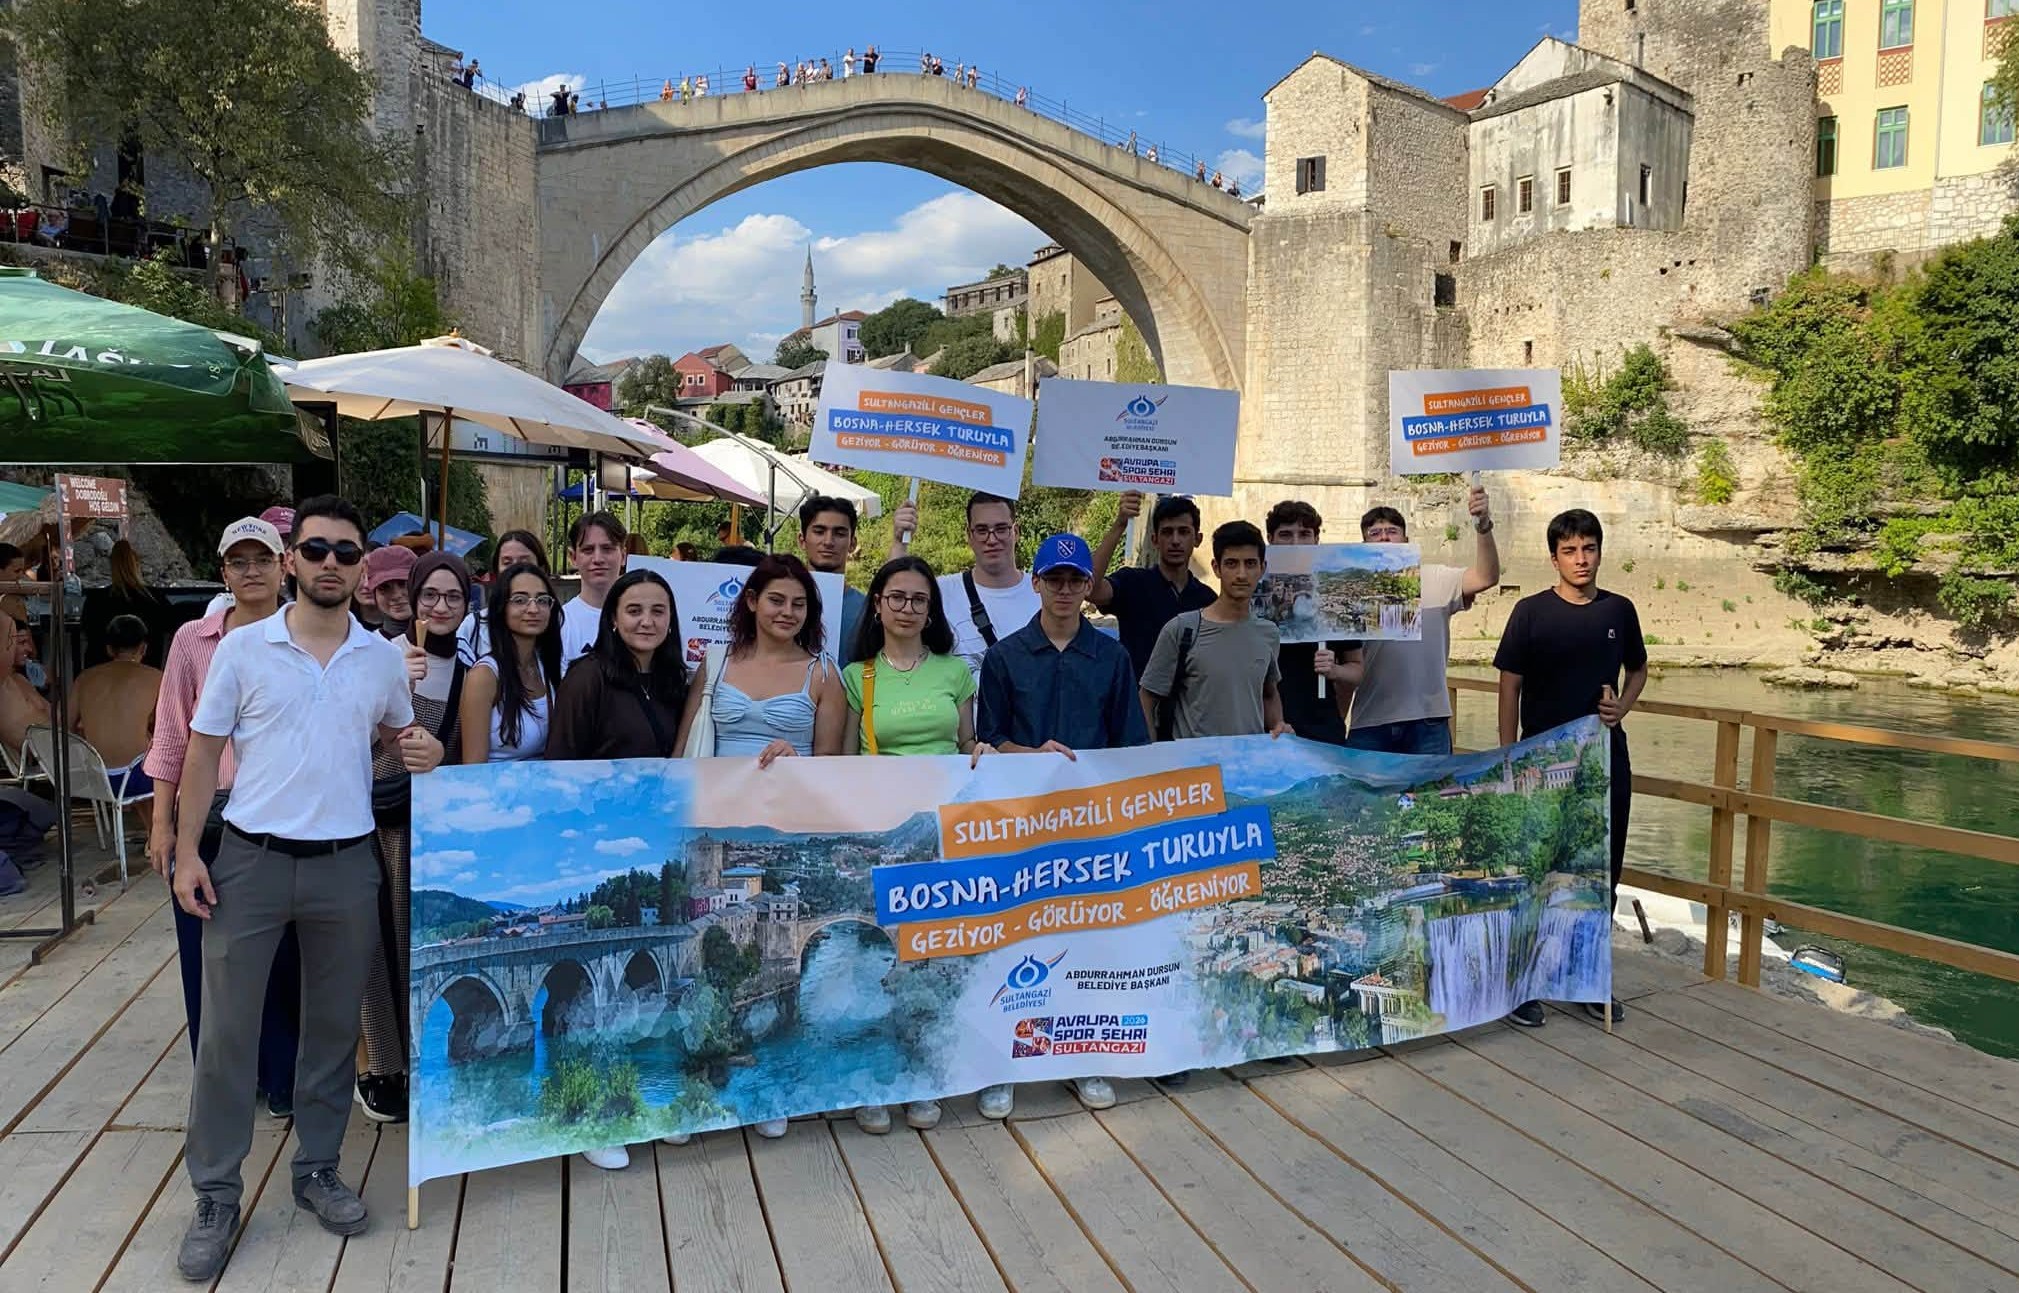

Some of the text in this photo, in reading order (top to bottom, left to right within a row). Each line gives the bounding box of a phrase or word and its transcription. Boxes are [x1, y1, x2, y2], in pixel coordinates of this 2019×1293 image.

[864, 397, 985, 420] SULTANGAZİLİ GENÇLER
[1428, 393, 1527, 410] SULTANGAZİLİ GENÇLER
[834, 416, 1009, 447] BOSNA-HERSEK TURUYLA
[1408, 411, 1547, 436] BOSNA-HERSEK TURUYLA
[841, 435, 881, 448] GEZİYOR
[891, 437, 936, 453] GÖRÜYOR
[947, 444, 1000, 463] ÖĞRENİYOR
[1122, 466, 1148, 475] SPOR
[1123, 458, 1159, 467] AVRUPA
[69, 477, 96, 489] WELCOME
[954, 782, 1214, 845] SULTANGAZİLİ GENÇLER
[888, 822, 1262, 913] BOSNA-HERSEK TURUYLA
[911, 921, 1006, 954] GEZİYOR
[1028, 902, 1125, 932] GÖRÜYOR
[1150, 872, 1251, 911] ÖĞRENİYOR
[1065, 962, 1180, 980] ABDURRAHMAN DURSUN
[1077, 976, 1170, 991] BELEDİYE BAŞKANI
[1000, 988, 1051, 1005] SULTANGAZİ
[1003, 999, 1046, 1013] BELEDİYESİ
[1055, 1015, 1119, 1027] AVRUPA
[1053, 1028, 1147, 1042] SPOR ŞEHRİ
[1055, 1041, 1144, 1054] SULTANGAZİ
